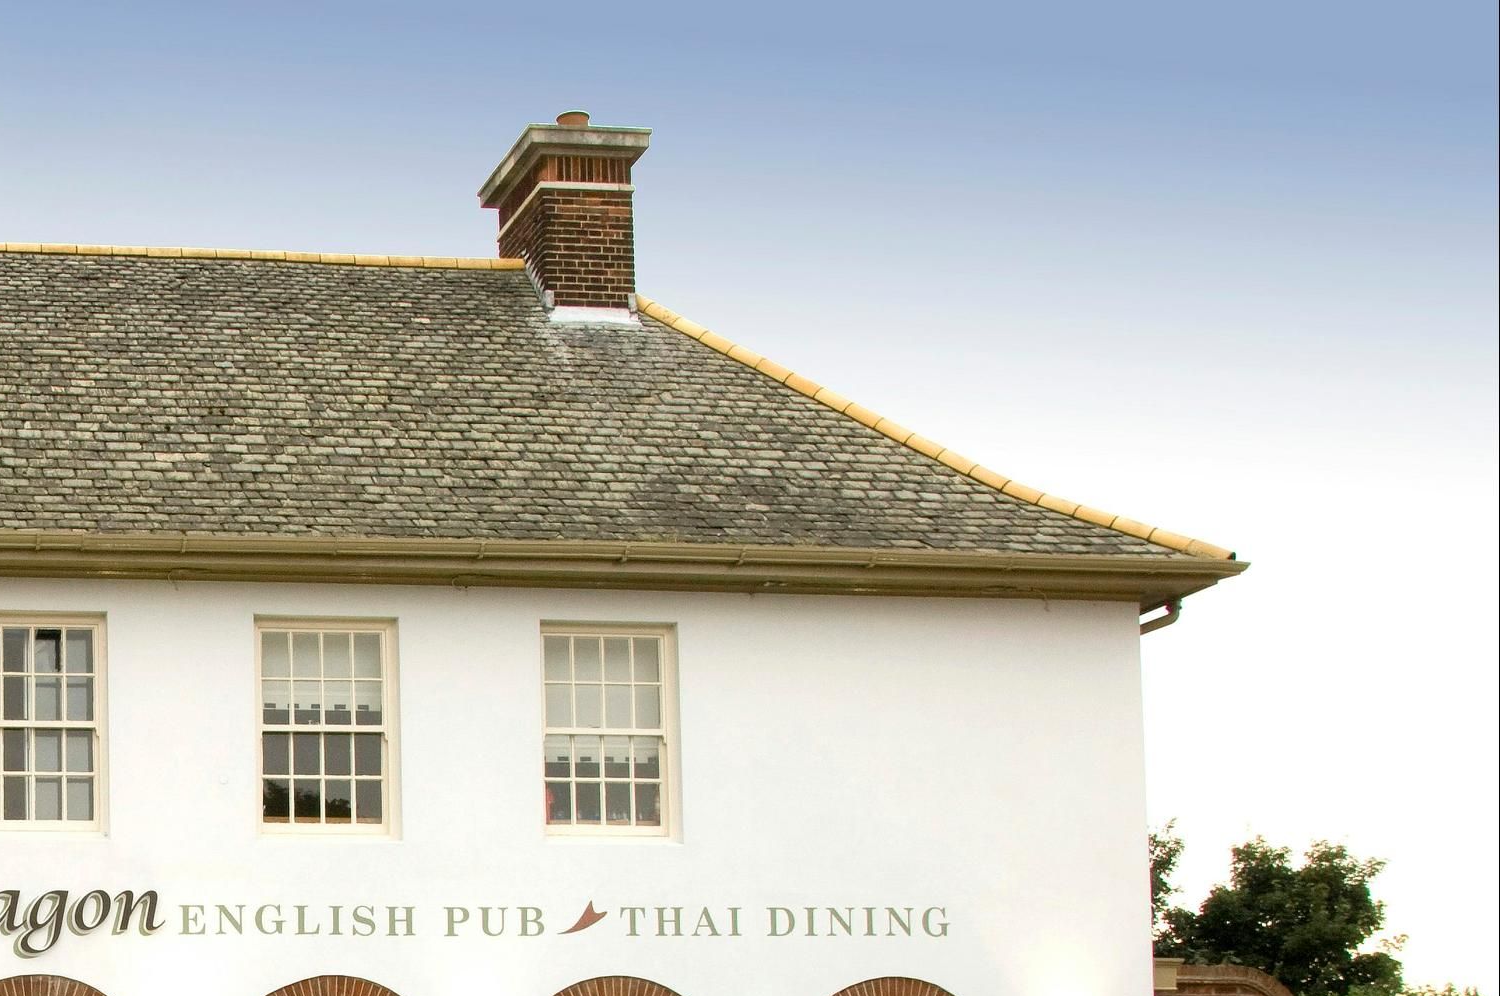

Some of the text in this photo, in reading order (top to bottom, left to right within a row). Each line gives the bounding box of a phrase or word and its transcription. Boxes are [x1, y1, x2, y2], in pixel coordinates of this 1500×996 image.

[178, 903, 952, 938] ENGLISH PUB THAI DINING
